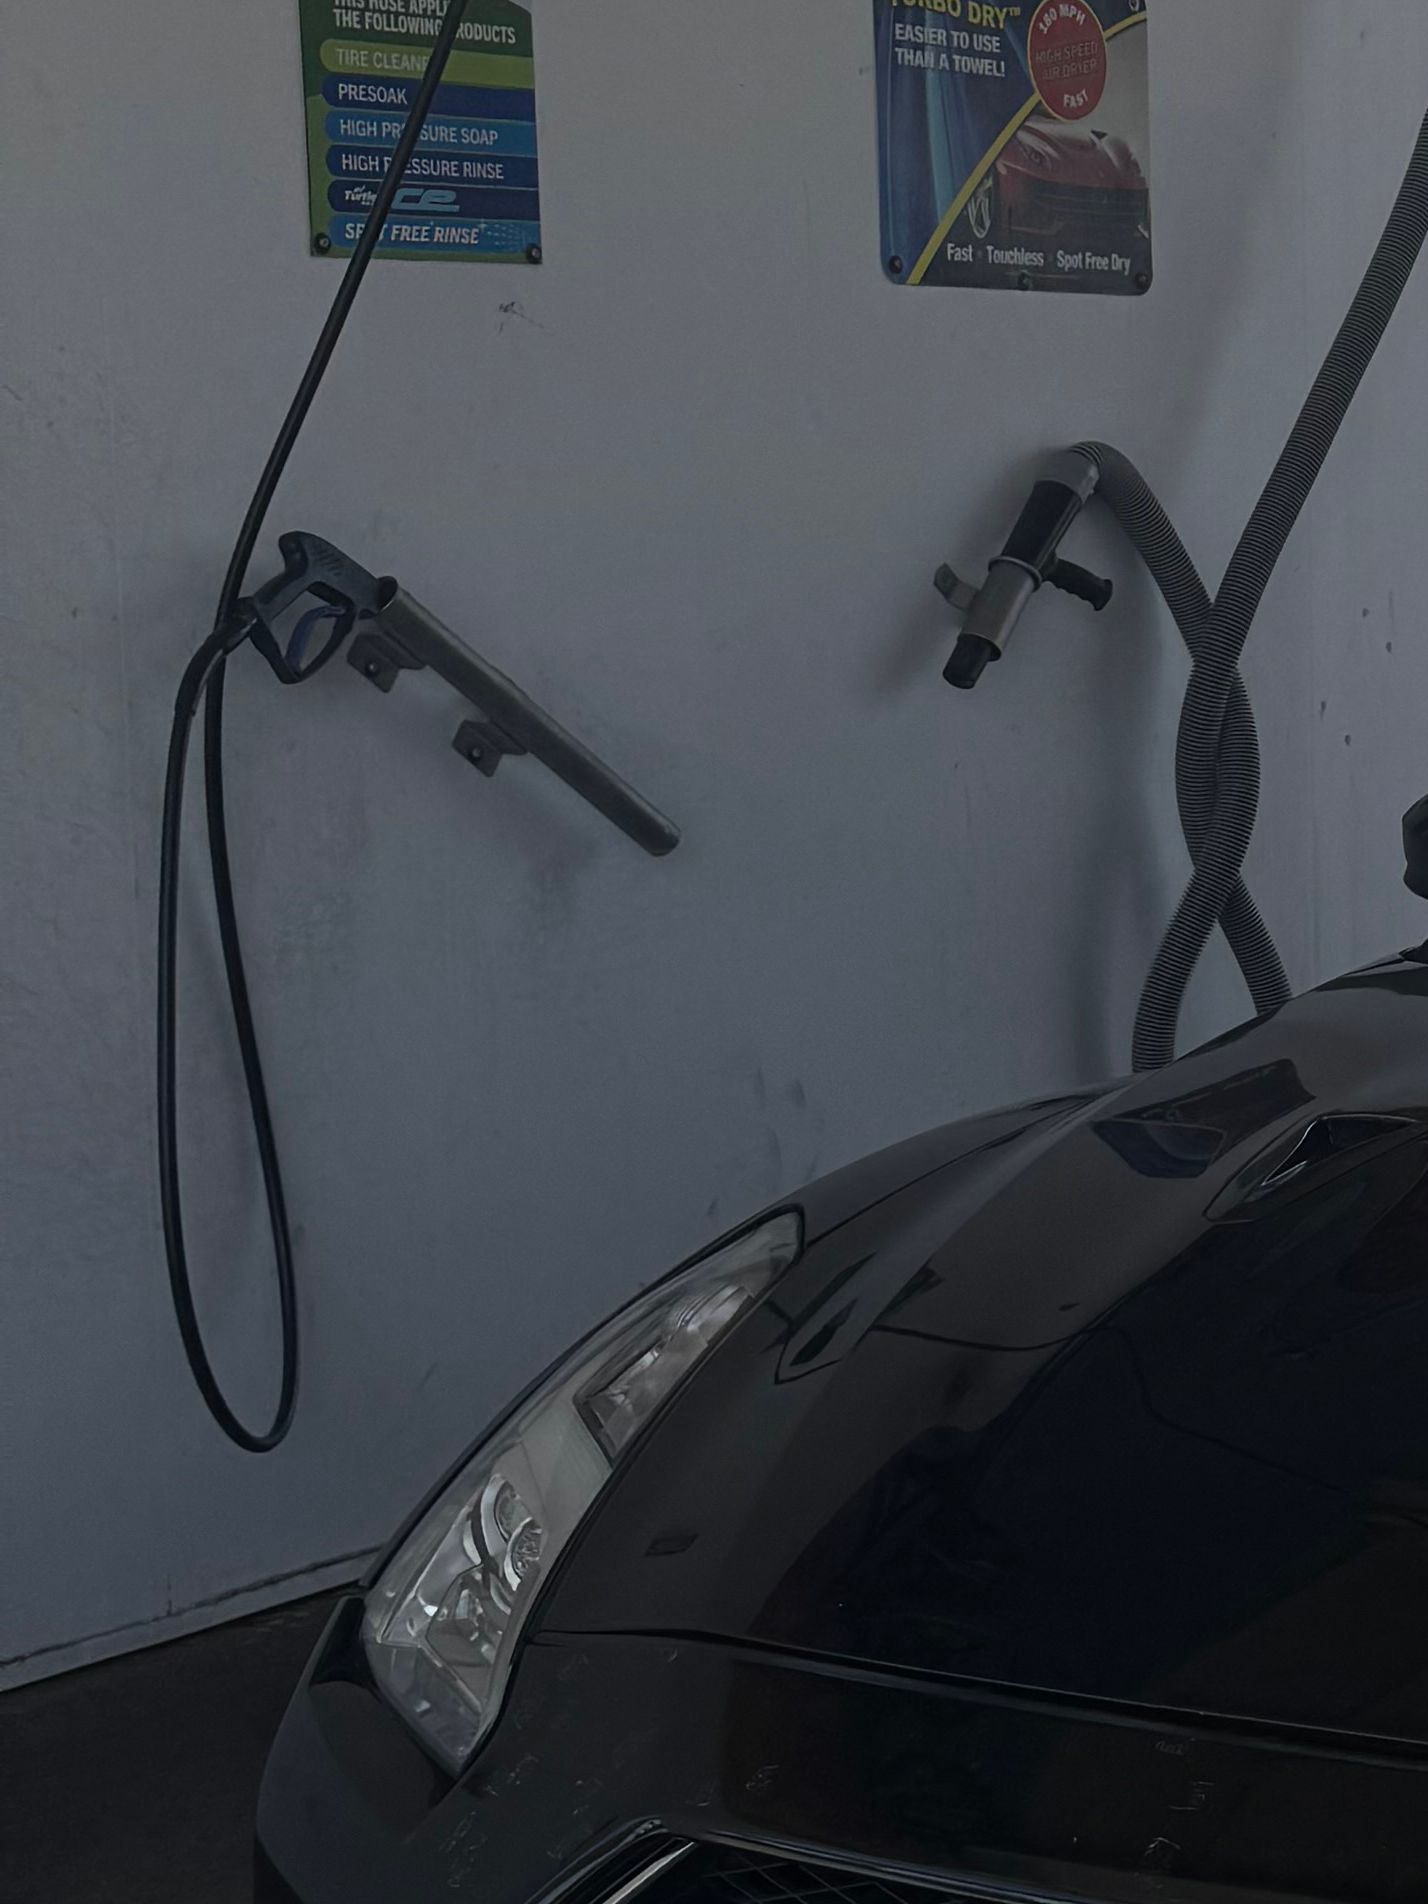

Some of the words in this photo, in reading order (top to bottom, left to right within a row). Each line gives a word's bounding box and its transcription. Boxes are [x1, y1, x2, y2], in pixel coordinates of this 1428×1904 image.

[333, 8, 361, 29] THE
[456, 22, 517, 44] RODUCTS
[1059, 3, 1086, 26] MPH
[895, 23, 948, 47] EASIER
[951, 30, 969, 49] TO
[973, 33, 1001, 53] USE
[335, 47, 369, 68] TIRE
[895, 47, 935, 69] THAN
[939, 53, 950, 71] A
[952, 55, 1006, 77] TOWEL!
[1063, 40, 1098, 61] SPEED
[338, 83, 408, 105] PRESOAK
[1063, 89, 1089, 109] FAST
[340, 119, 377, 137] HIGH
[460, 128, 499, 145] SOAP
[341, 154, 379, 172] HIGH
[462, 161, 505, 179] RINSE
[390, 224, 431, 242] FREE
[433, 227, 480, 245] RINSE
[947, 242, 974, 263] Fast
[986, 245, 1045, 267] Touchless
[1057, 249, 1082, 272] Spot
[1085, 252, 1109, 271] Free
[1111, 253, 1132, 276] Dry
